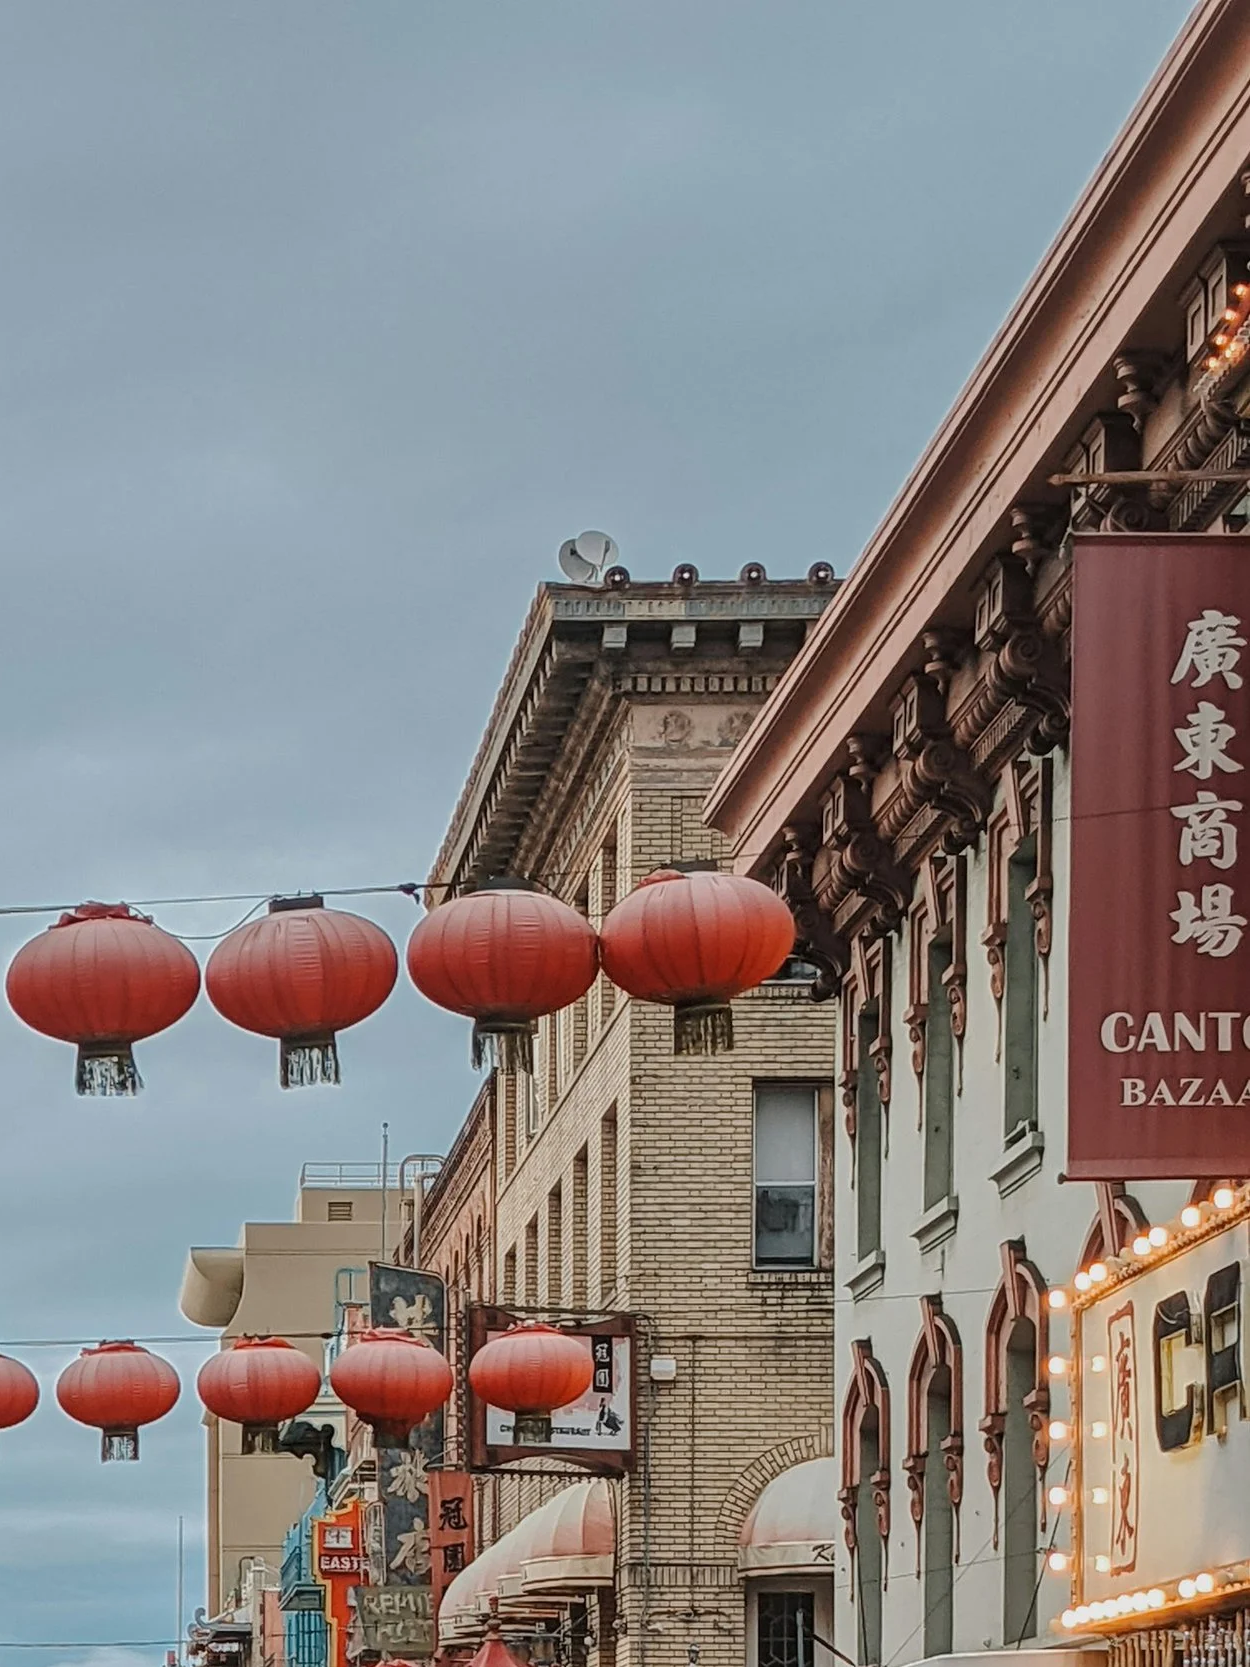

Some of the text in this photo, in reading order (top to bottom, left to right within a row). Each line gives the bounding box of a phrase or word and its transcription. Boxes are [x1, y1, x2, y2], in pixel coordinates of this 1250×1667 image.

[1170, 609, 1247, 957] 廣東商場
[1100, 1011, 1250, 1054] CANT
